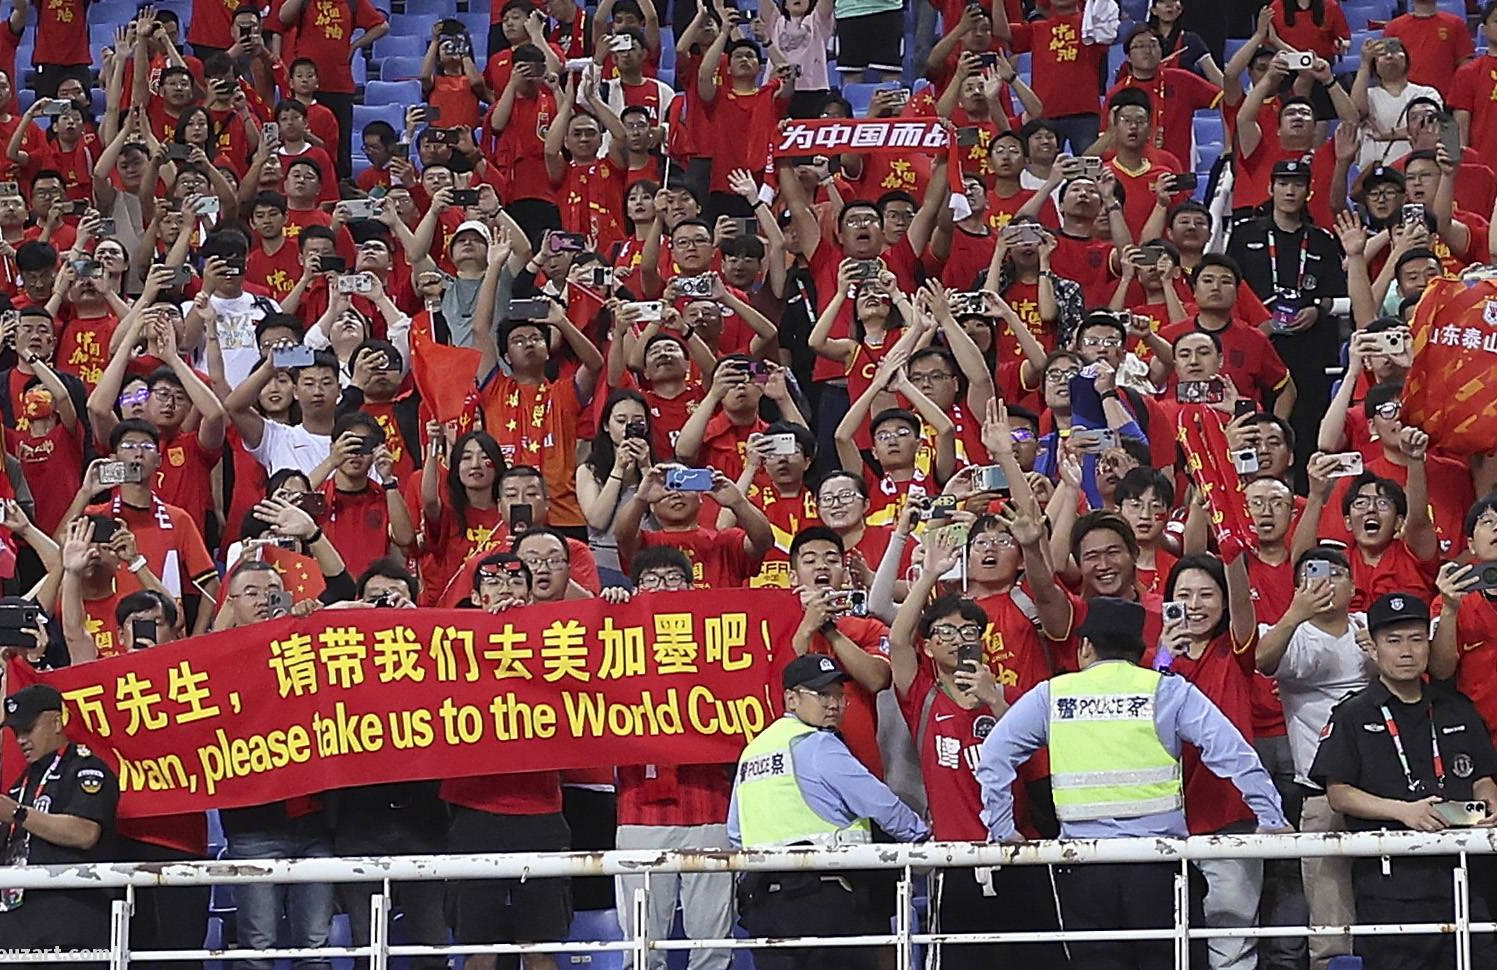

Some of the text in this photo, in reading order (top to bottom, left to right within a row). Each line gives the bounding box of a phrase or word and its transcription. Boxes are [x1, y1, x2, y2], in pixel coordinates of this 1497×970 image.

[61, 612, 773, 738] 万先生，请带我们去美加墨吧！
[199, 724, 311, 795] please
[313, 702, 384, 760] take
[389, 708, 435, 751] us
[439, 696, 484, 746] to
[489, 690, 557, 742] the
[561, 686, 686, 739] World
